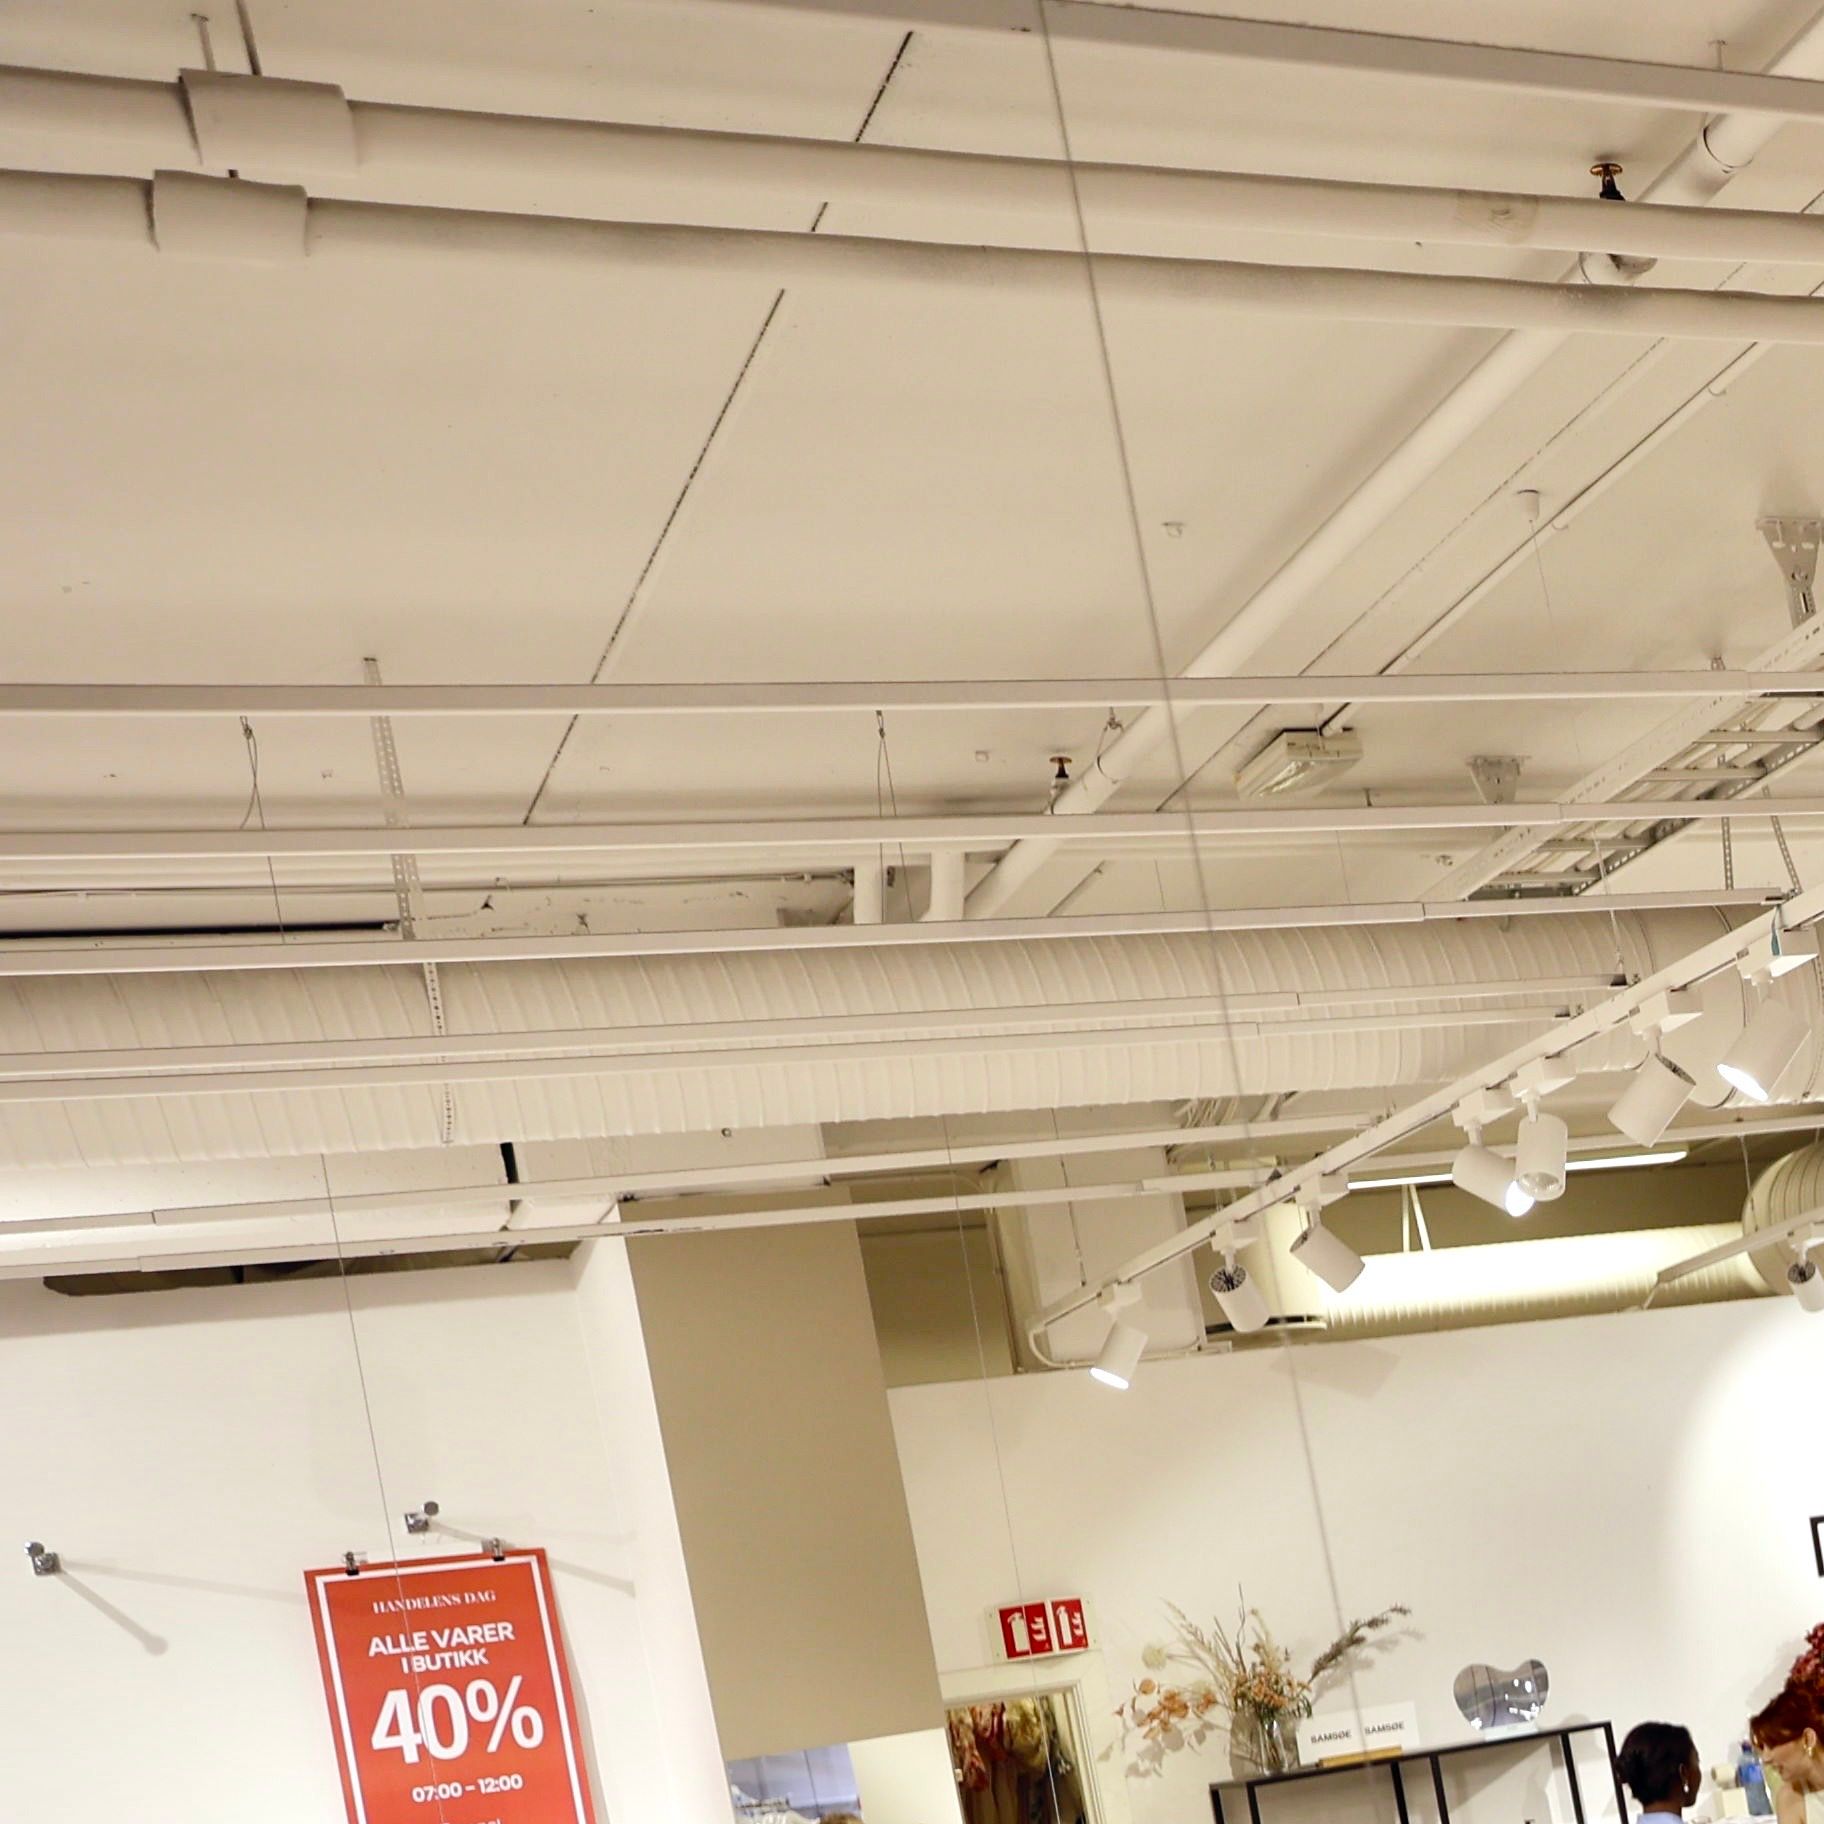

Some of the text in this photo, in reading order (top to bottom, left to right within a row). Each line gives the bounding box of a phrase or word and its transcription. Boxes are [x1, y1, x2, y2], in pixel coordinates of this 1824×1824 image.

[372, 1589, 497, 1614] HANDELENS DAG
[368, 1621, 516, 1658] ALLE VARER
[401, 1648, 490, 1674] I BUTIKK
[371, 1675, 545, 1764] 40%
[1310, 1721, 1405, 1744] SAMSØE SAMSØE
[412, 1781, 463, 1803] 07:00
[477, 1773, 523, 1795] 12:00
